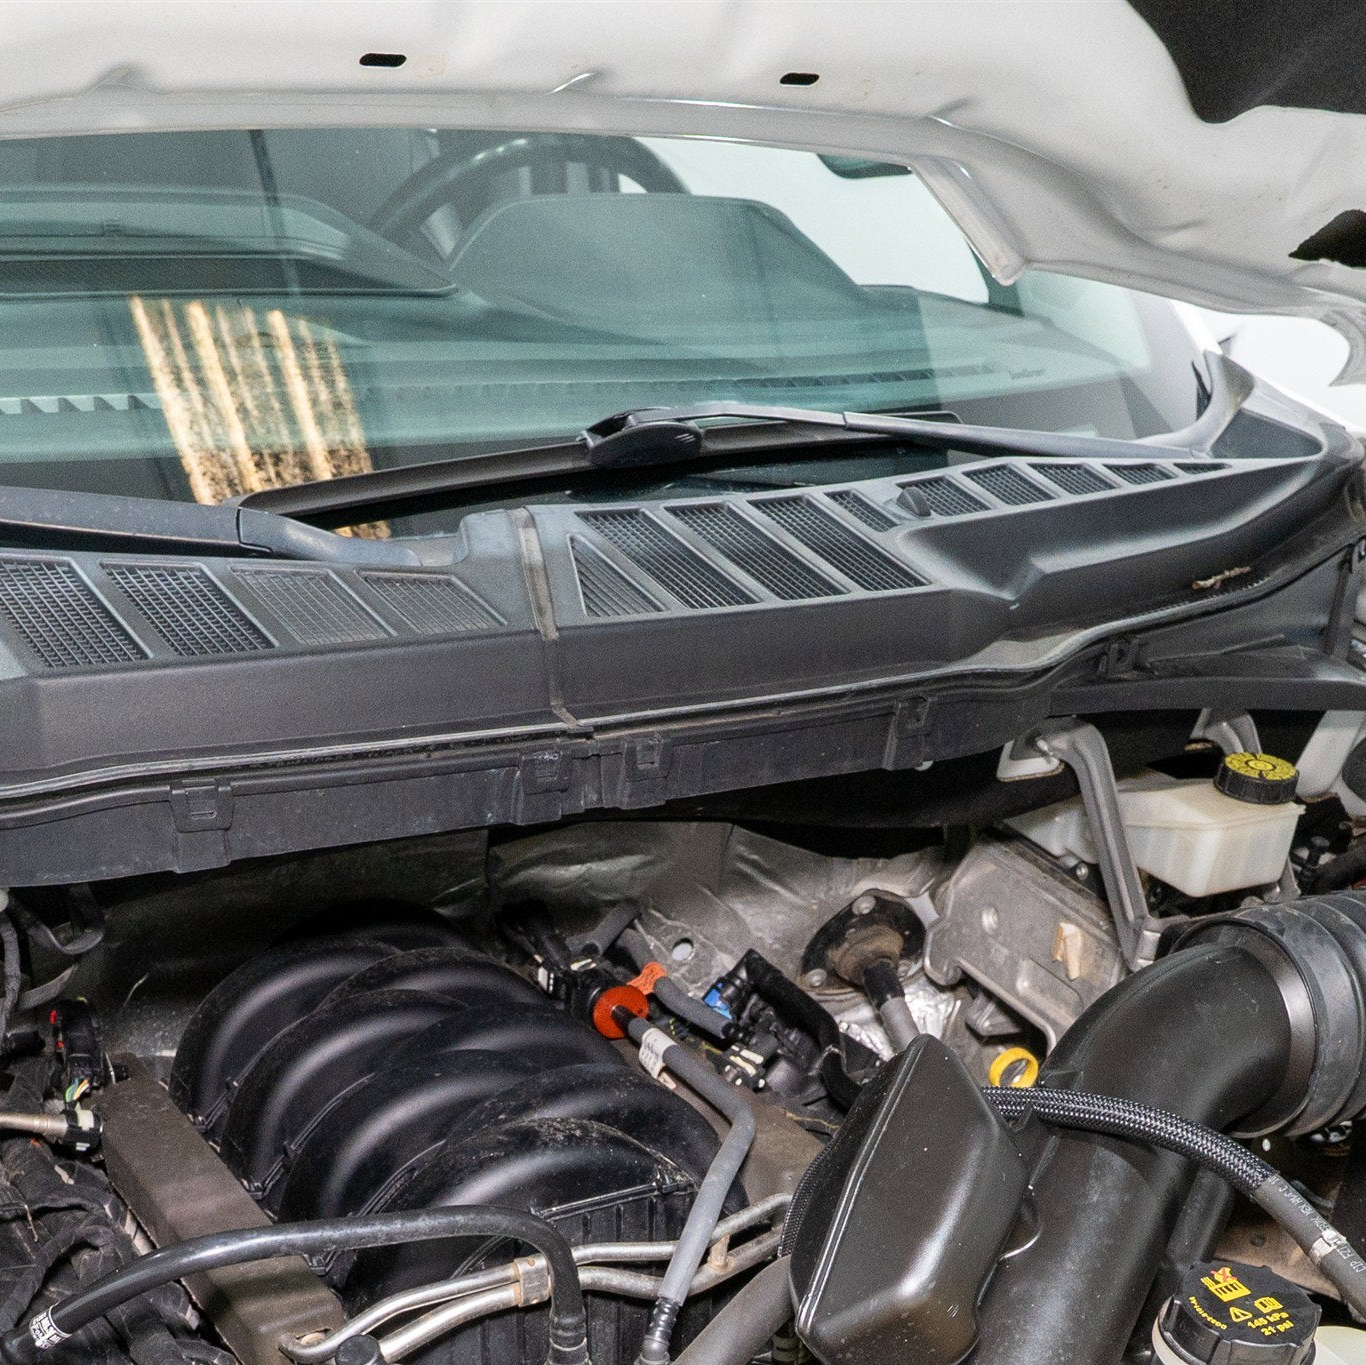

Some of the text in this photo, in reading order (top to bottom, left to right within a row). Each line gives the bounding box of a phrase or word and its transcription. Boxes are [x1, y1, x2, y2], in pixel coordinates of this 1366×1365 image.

[1247, 1312, 1289, 1329] 145 kPa
[1261, 1320, 1294, 1336] 21 psi
